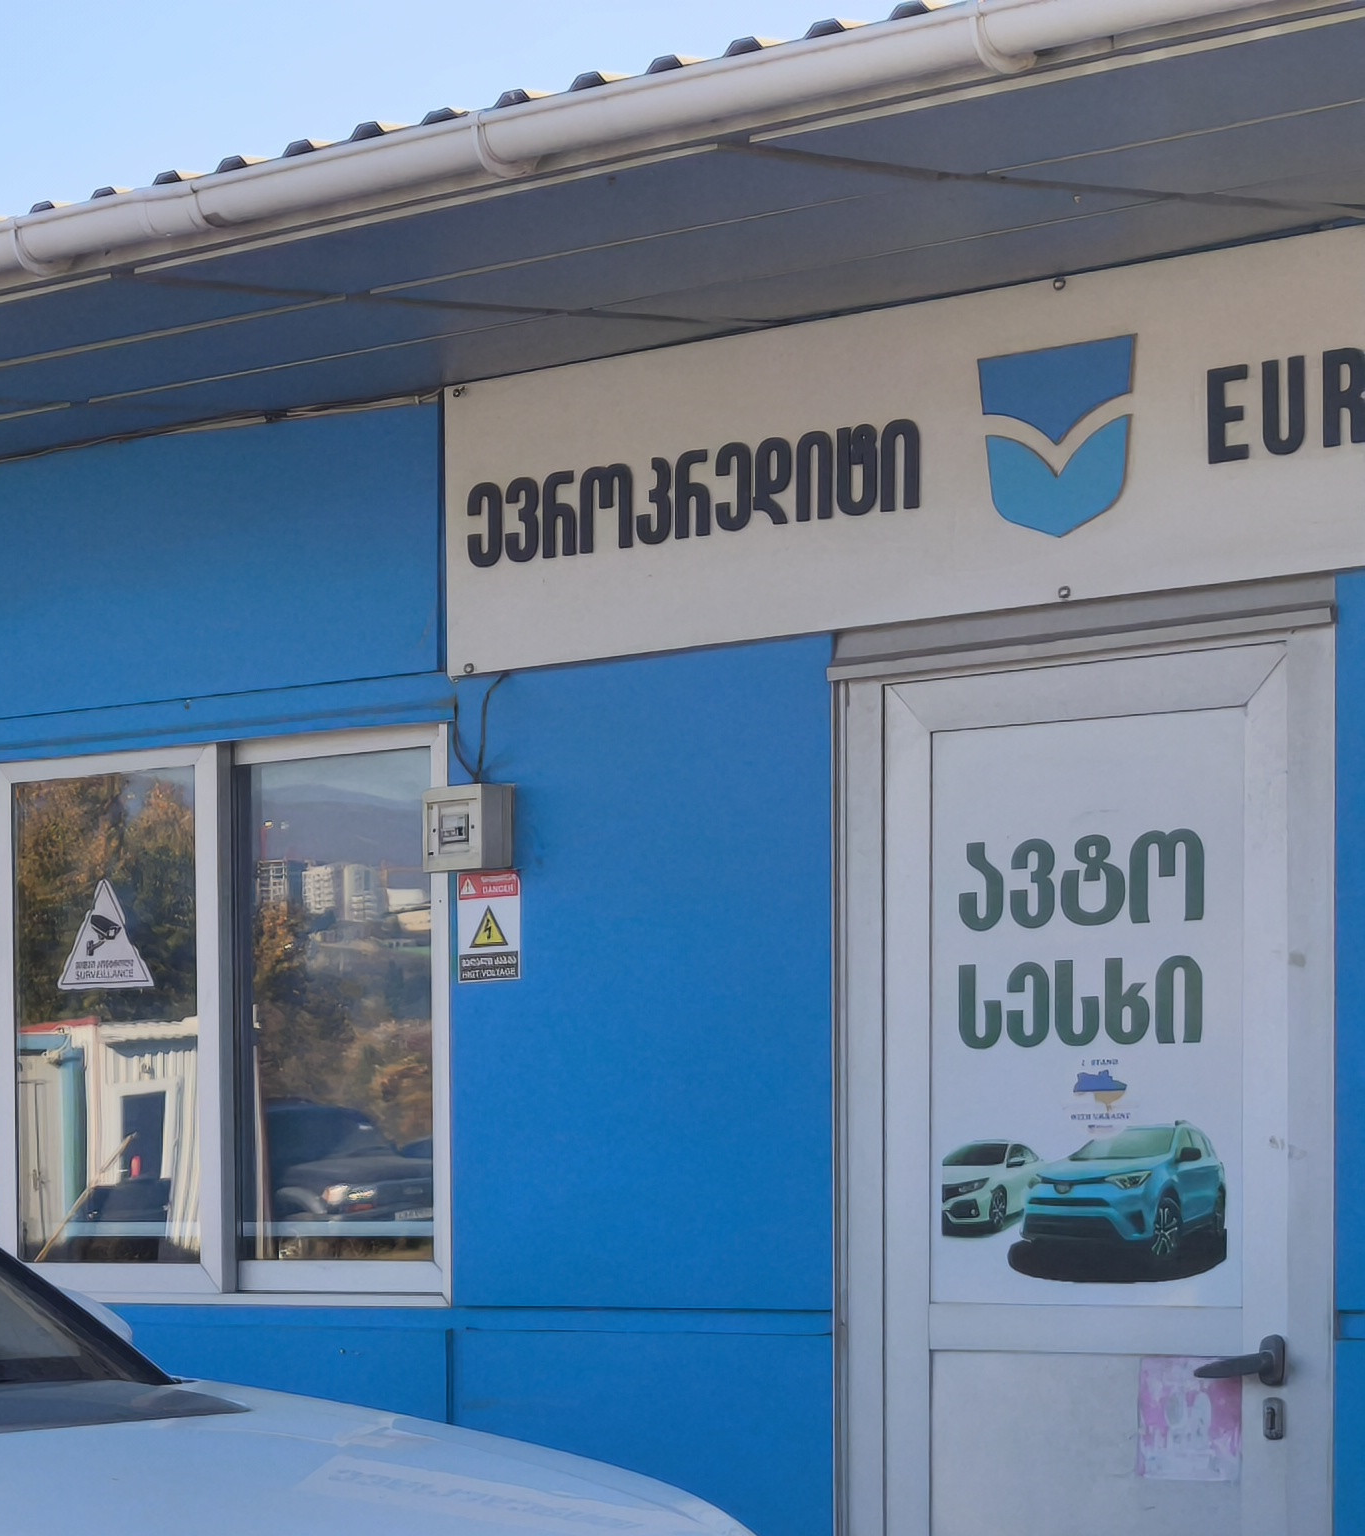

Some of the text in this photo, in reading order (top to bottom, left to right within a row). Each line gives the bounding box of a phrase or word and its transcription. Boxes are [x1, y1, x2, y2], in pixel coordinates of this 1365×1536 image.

[1206, 346, 1365, 465] EUR
[467, 417, 922, 568] ევროკრედიტი
[958, 828, 1205, 932] ავტო
[958, 955, 1203, 1050] სესხი
